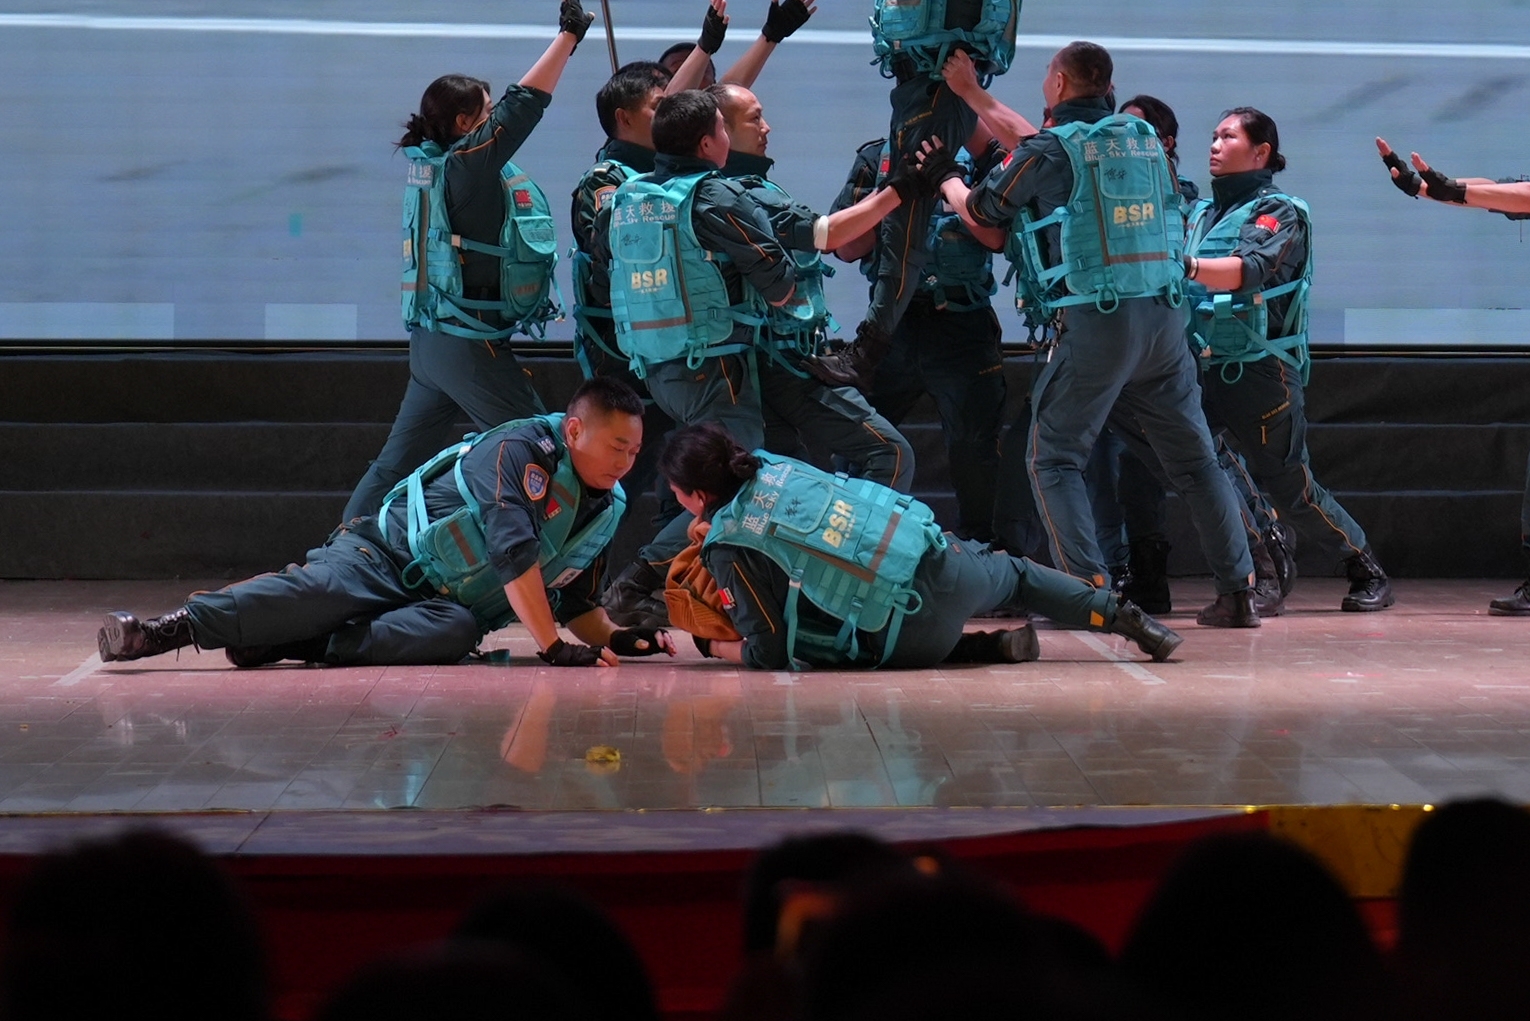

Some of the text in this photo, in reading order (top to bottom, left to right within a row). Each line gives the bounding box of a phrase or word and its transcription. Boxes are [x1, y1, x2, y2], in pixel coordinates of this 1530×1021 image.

[1084, 137, 1157, 154] 蓝天救援
[1085, 154, 1106, 162] Blue
[1108, 150, 1126, 158] Sky
[642, 214, 676, 223] Rescue
[1114, 203, 1154, 224] BSR
[631, 268, 668, 290] BSR
[755, 512, 770, 535] Blue
[765, 490, 779, 509] Sky
[822, 500, 853, 548] BSR
